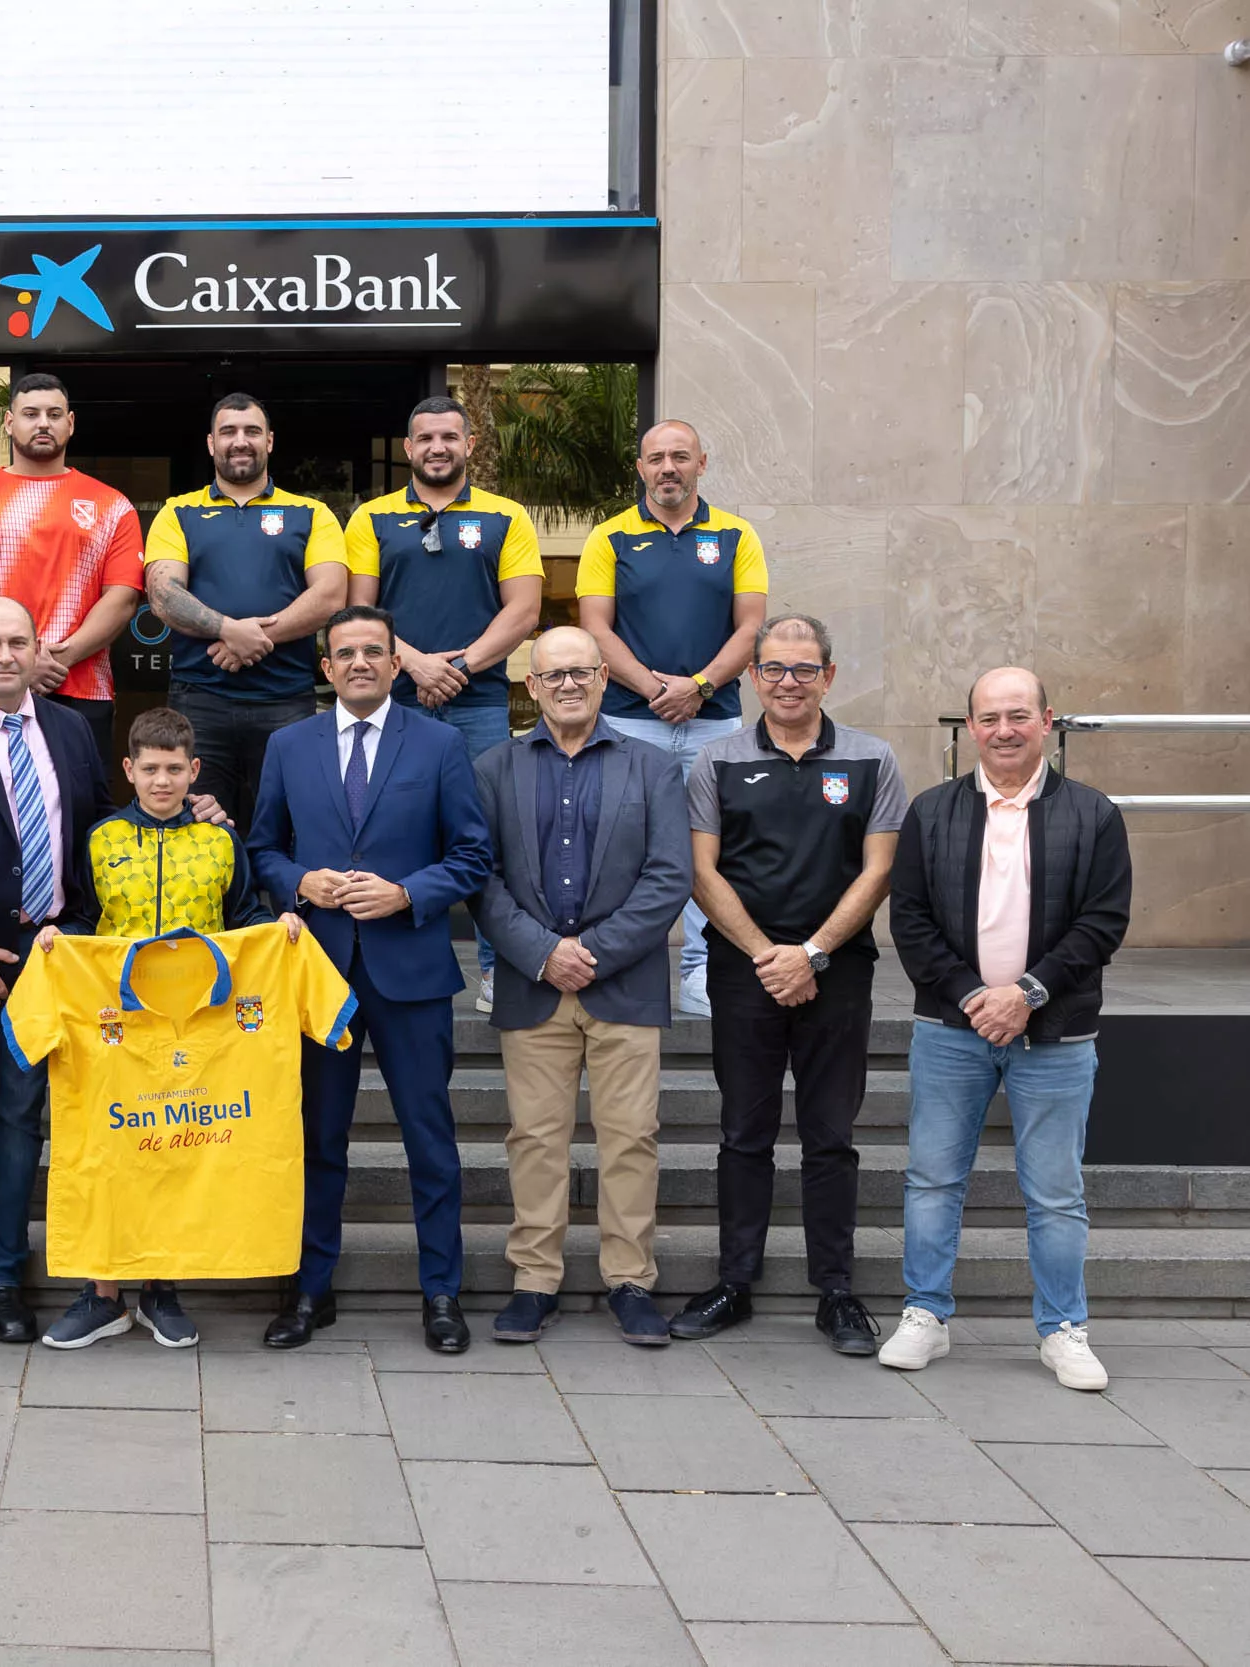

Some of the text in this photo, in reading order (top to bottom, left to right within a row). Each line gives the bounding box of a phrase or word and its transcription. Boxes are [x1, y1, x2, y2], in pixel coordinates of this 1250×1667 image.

[134, 252, 462, 312] CaixaBank
[131, 654, 173, 670] TE
[137, 1087, 208, 1102] AYUNTAMIENTO
[108, 1089, 252, 1130] San Miguel
[138, 1127, 232, 1152] de abona
